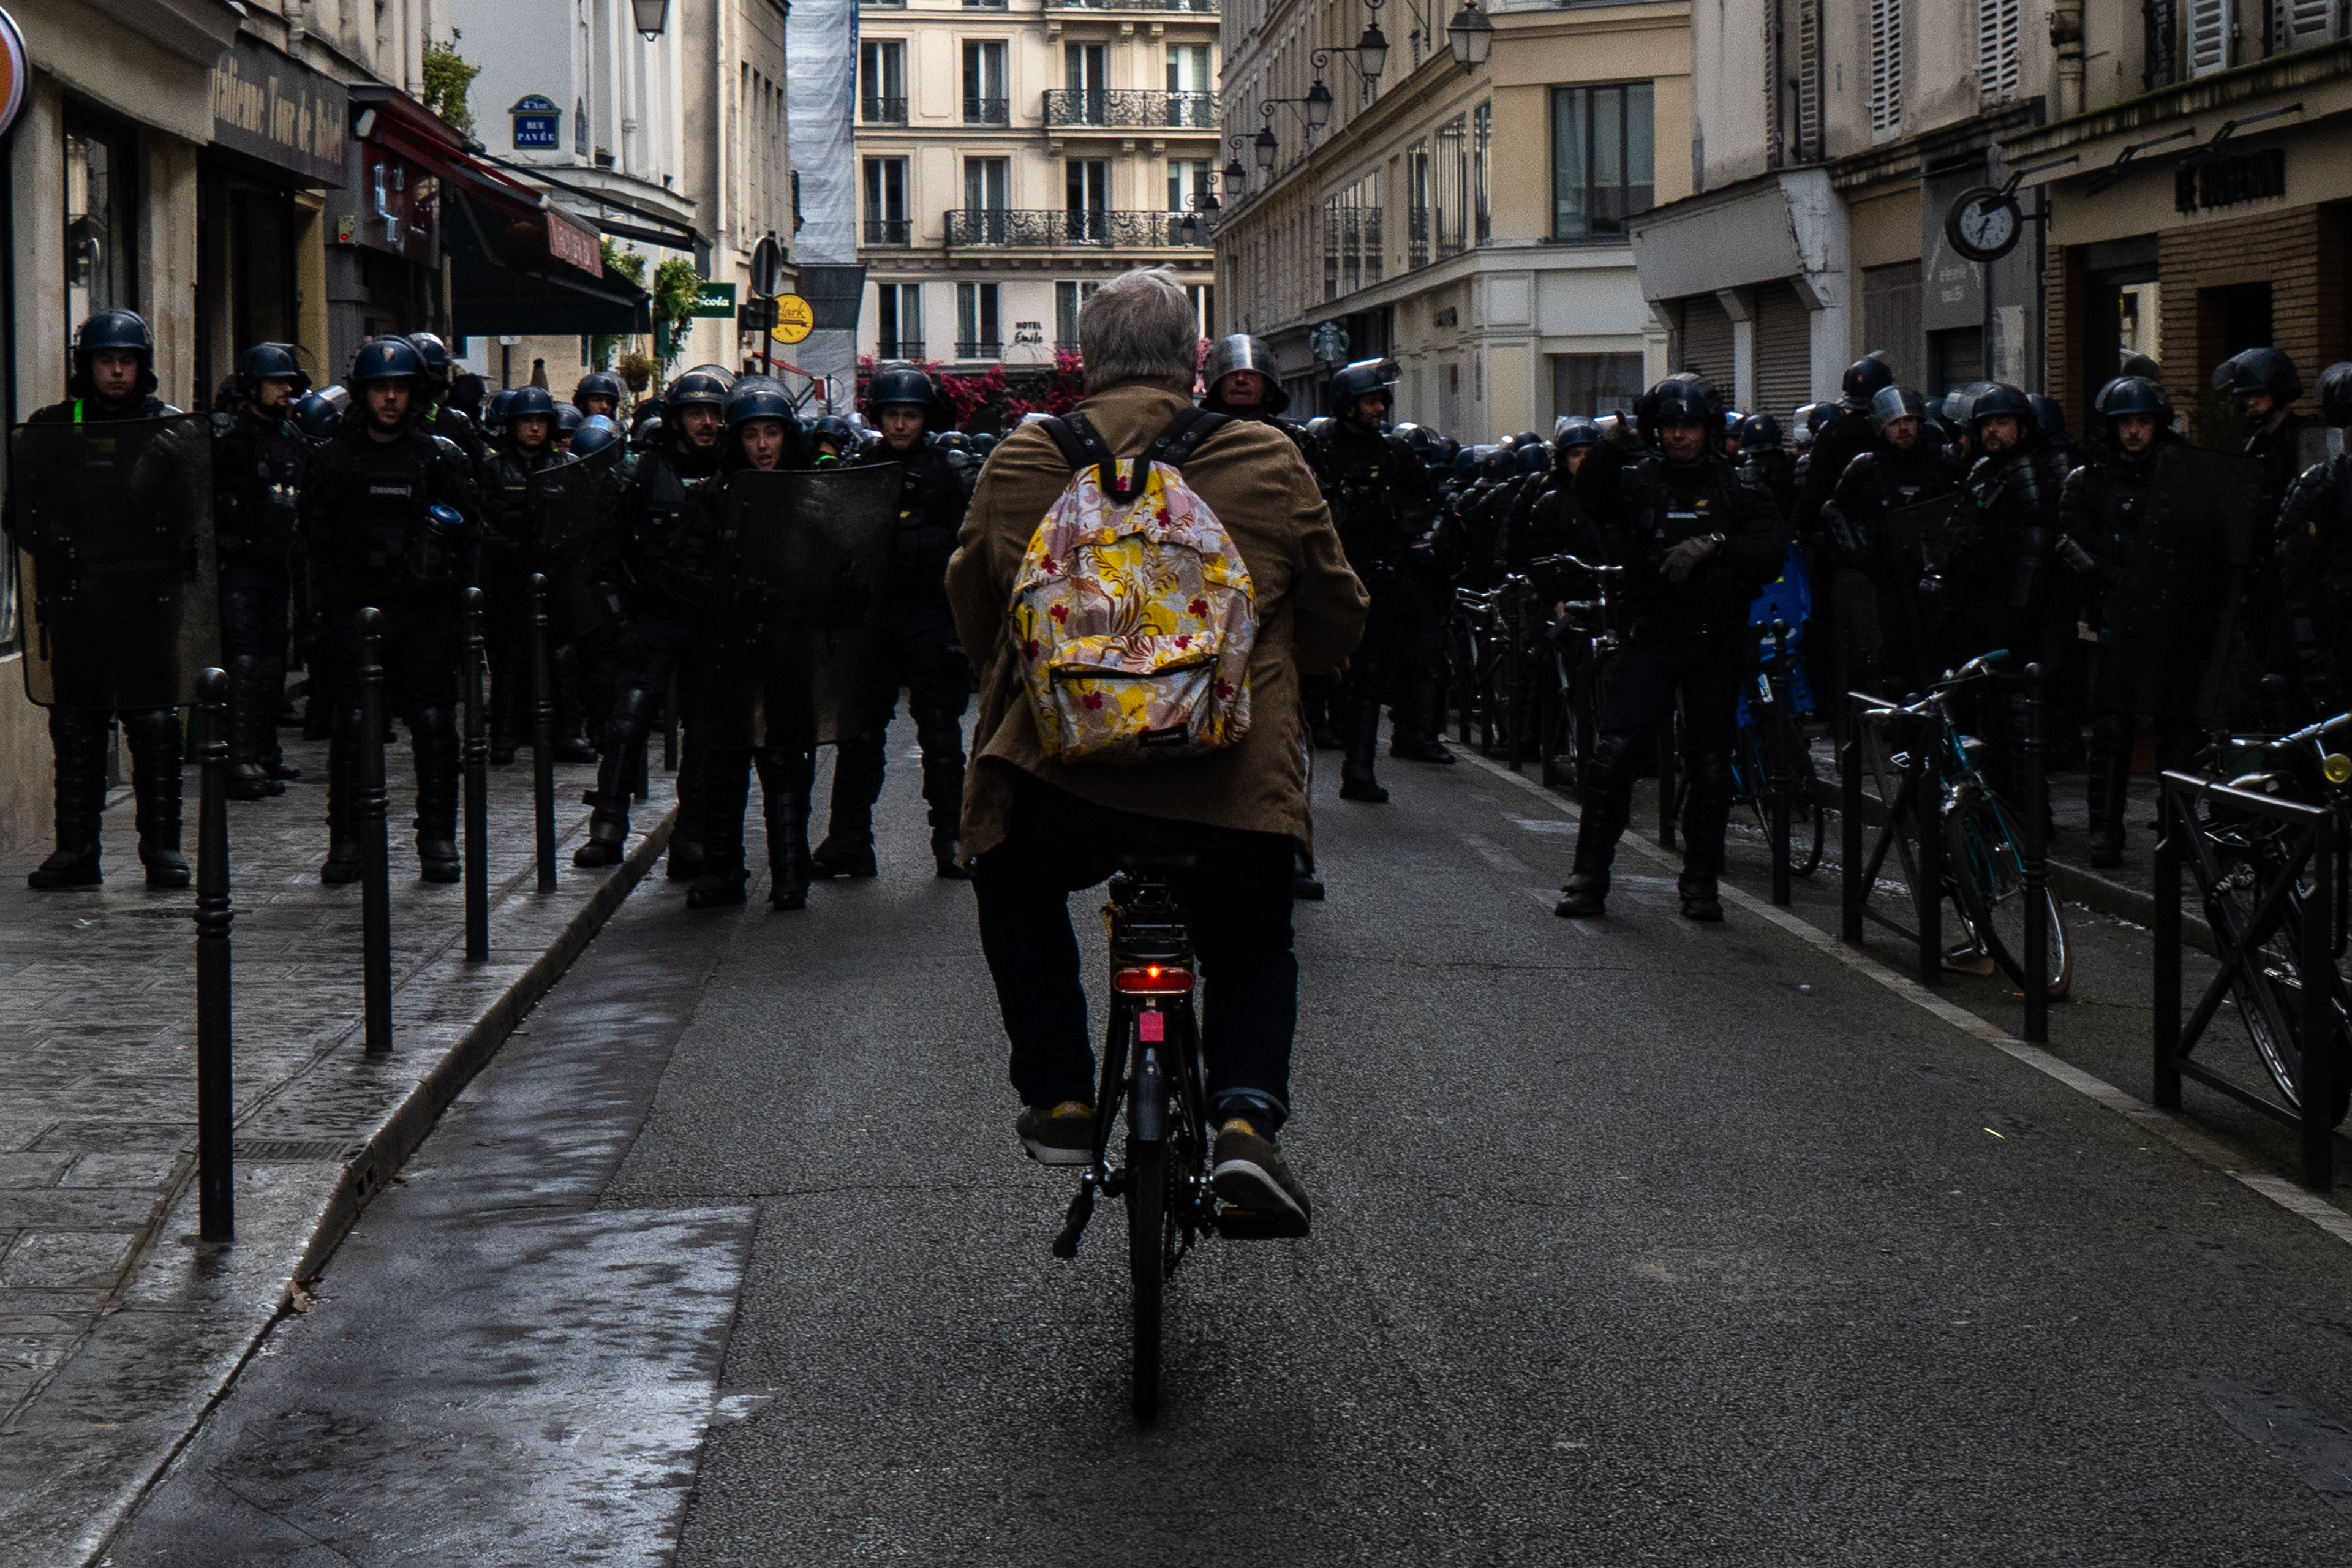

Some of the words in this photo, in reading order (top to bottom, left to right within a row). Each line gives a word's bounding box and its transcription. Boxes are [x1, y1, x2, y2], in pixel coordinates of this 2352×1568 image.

[268, 75, 295, 146] Tour
[298, 91, 311, 153] de
[527, 121, 545, 130] RUE
[517, 131, 555, 141] PAVÉE
